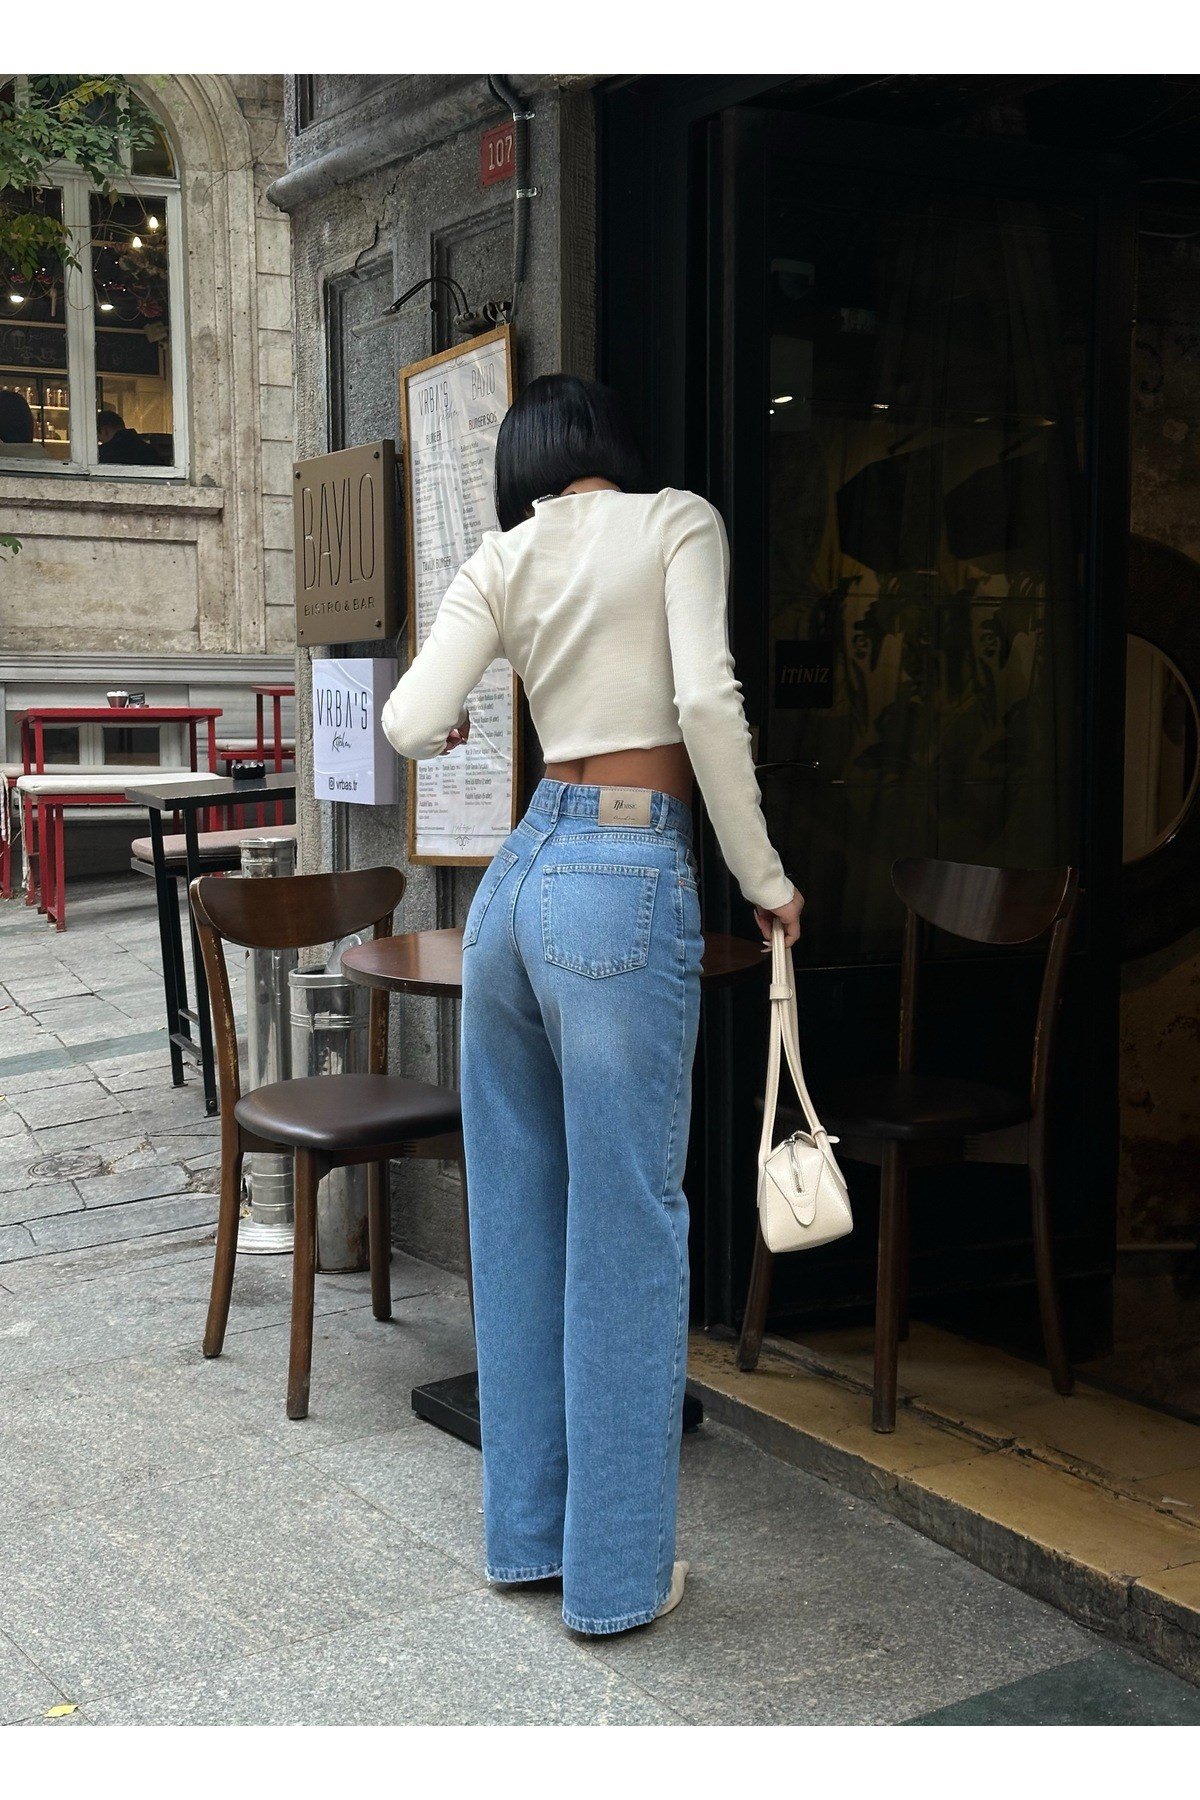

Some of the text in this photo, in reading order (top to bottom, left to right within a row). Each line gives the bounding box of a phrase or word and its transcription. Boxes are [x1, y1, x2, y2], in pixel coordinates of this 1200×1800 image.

[489, 134, 513, 171] 107
[471, 362, 496, 401] BAYLO
[302, 472, 375, 591] BAYLO
[304, 596, 376, 617] BISTRO & BAR
[316, 688, 368, 730] VRBA'S
[336, 778, 358, 792] vrbas.tr
